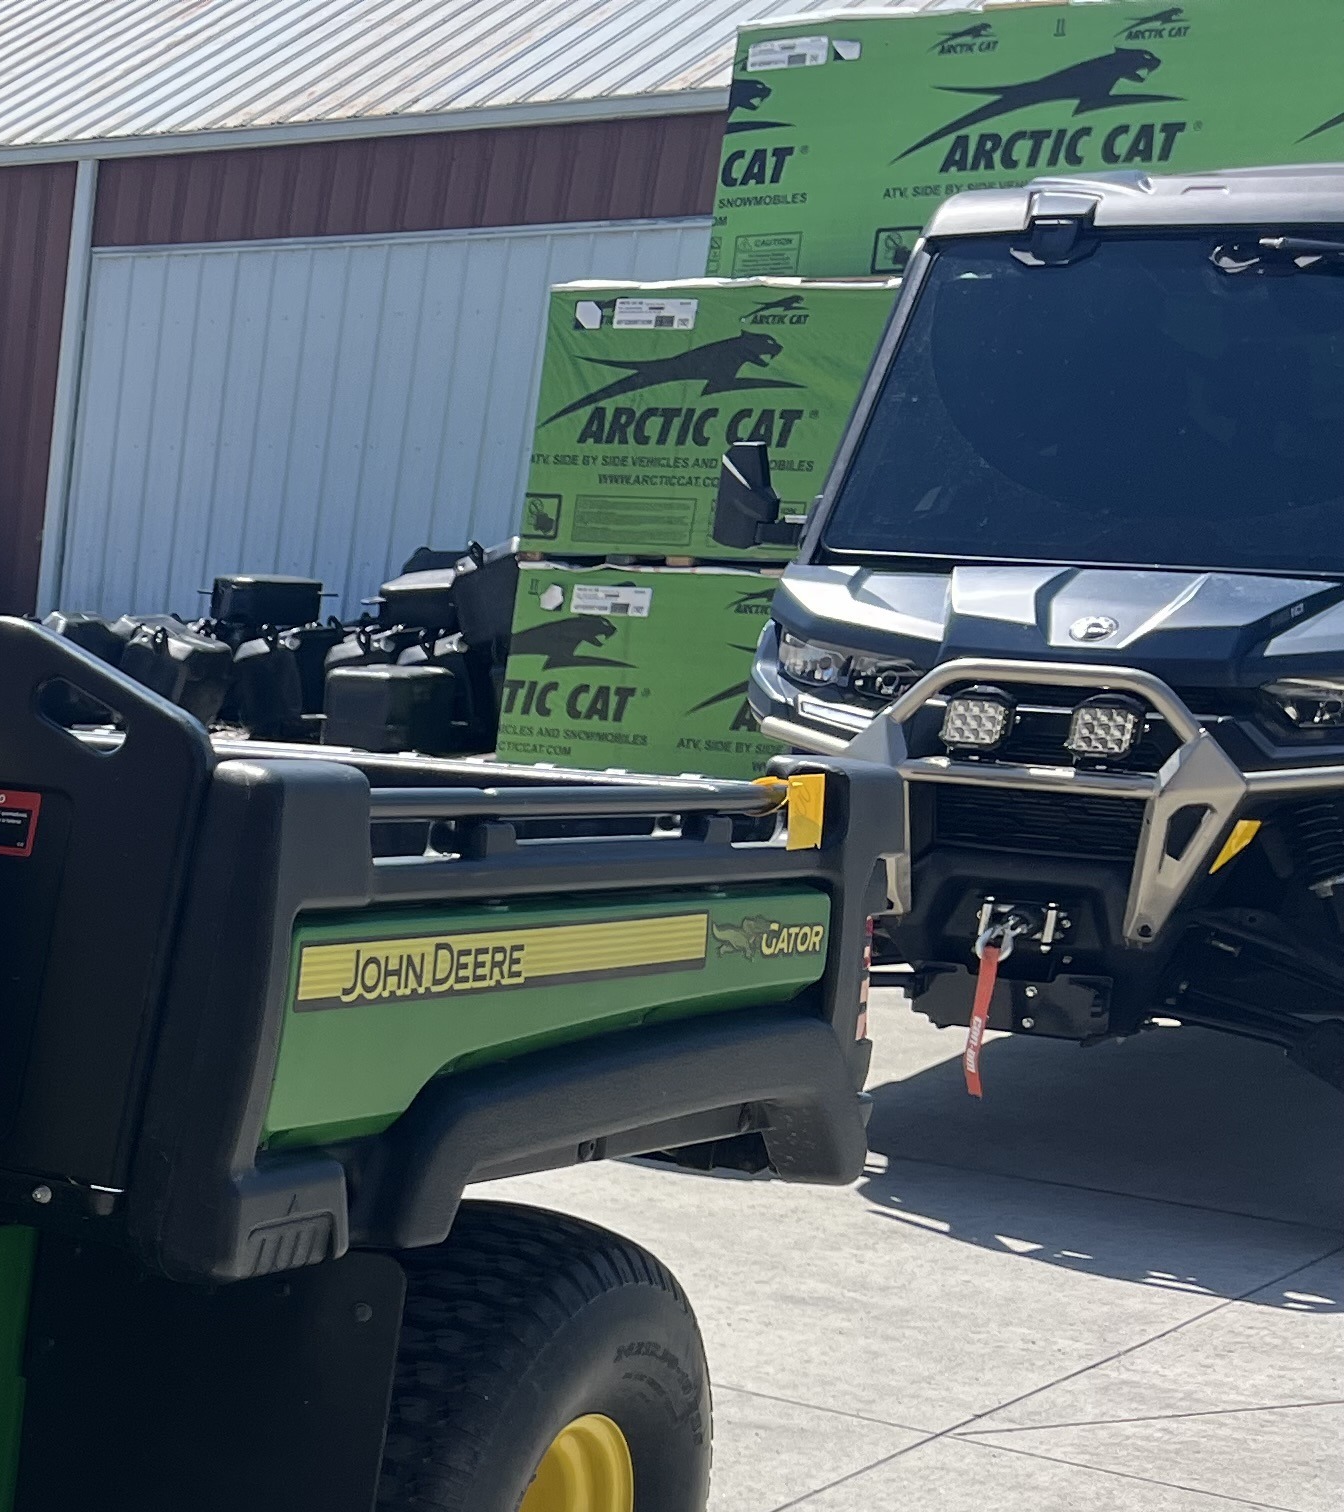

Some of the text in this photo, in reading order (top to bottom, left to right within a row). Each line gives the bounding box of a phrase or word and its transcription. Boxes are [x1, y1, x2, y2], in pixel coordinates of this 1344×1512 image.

[1125, 26, 1191, 40] ARCTIC CAT
[938, 40, 998, 55] ARCTIC CAT
[938, 121, 1186, 173] ARCTIC CAT
[720, 146, 795, 187] CAT
[912, 184, 941, 197] SIDE
[944, 183, 963, 195] BY
[718, 193, 808, 209] SNOWMOBILES
[754, 238, 793, 248] CAUTION
[750, 314, 809, 325] ARCTIC CAT
[577, 406, 804, 449] ARCTIC CAT
[553, 454, 580, 466] SIDE
[582, 455, 598, 467] BY
[601, 455, 628, 467] SIDE
[631, 456, 690, 469] VEHICLES
[691, 458, 718, 469] AND
[598, 474, 720, 488] WWW.ARCTICCAT.CO
[565, 683, 637, 722] CAT
[537, 727, 561, 738] AND
[563, 729, 648, 746] SNOWMOBILES
[761, 922, 824, 955] GATOR
[341, 942, 526, 998] JOHN DEERE
